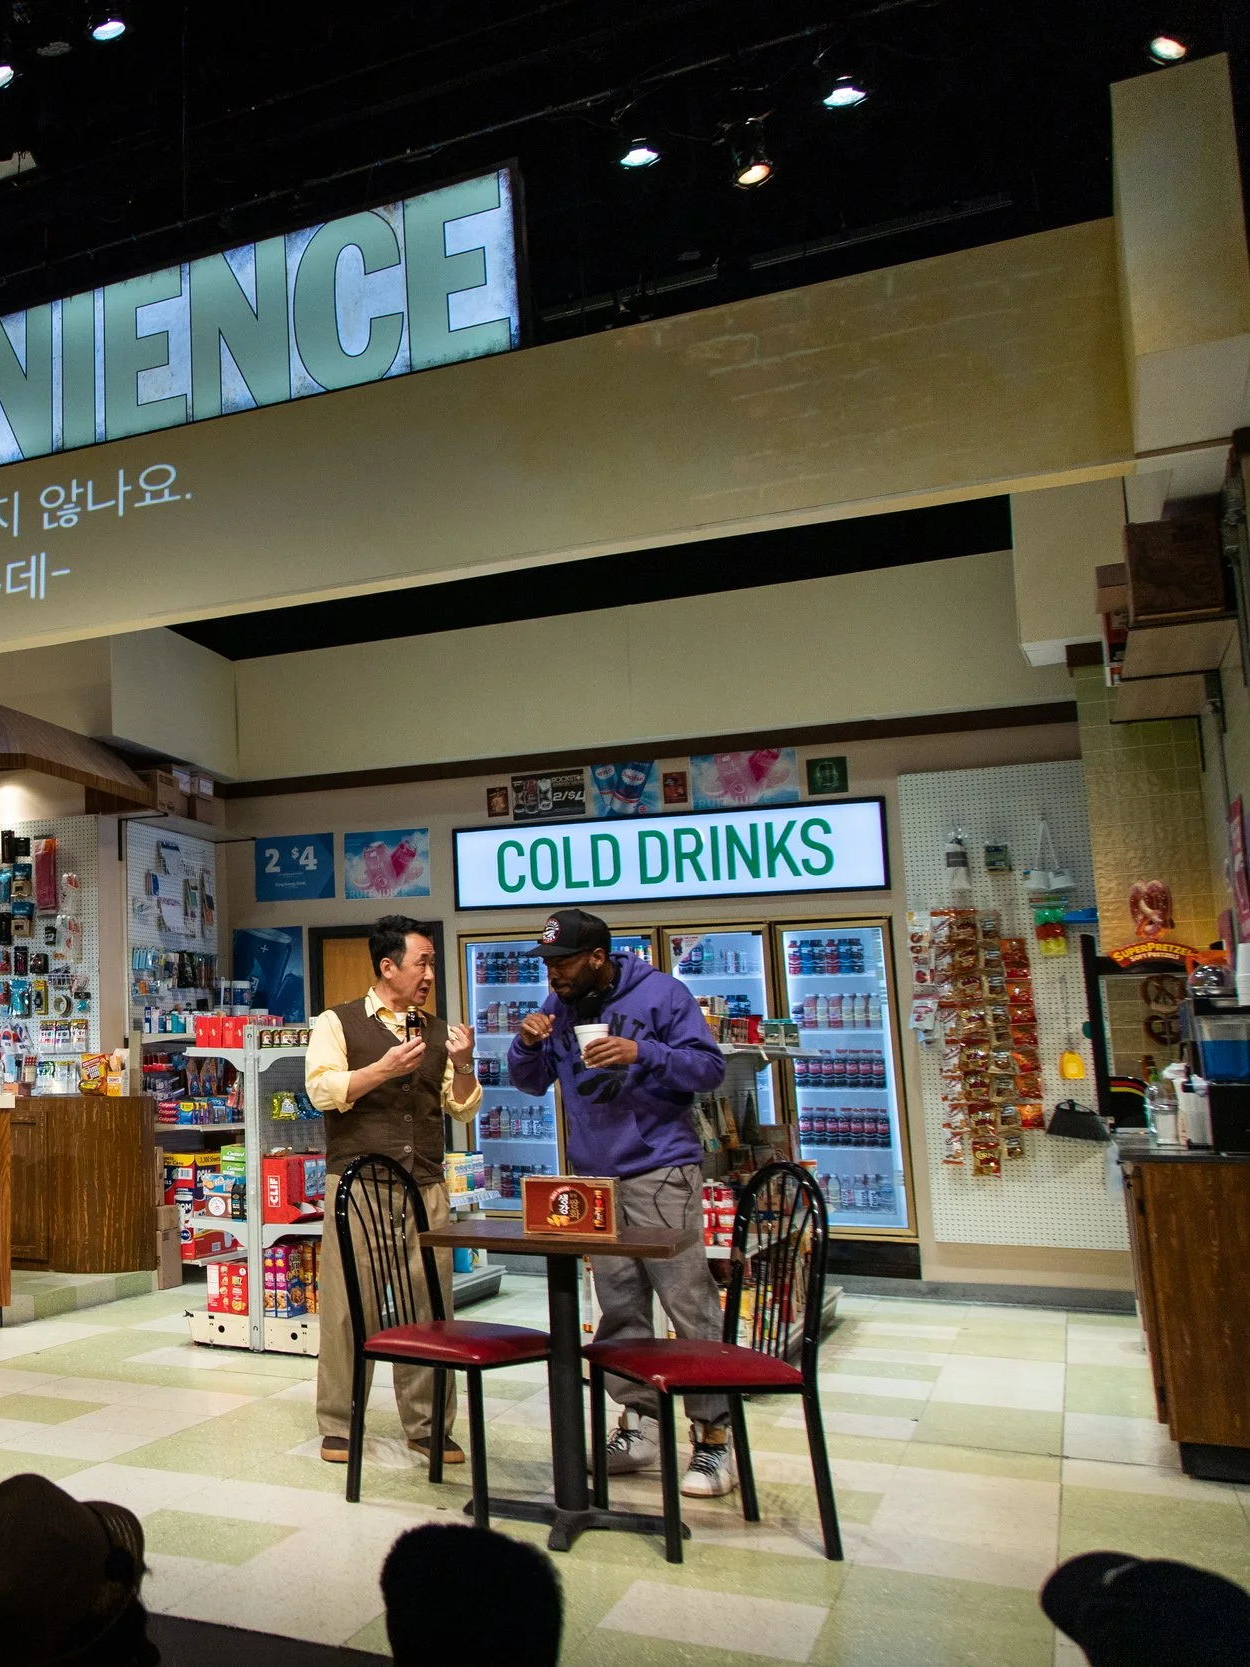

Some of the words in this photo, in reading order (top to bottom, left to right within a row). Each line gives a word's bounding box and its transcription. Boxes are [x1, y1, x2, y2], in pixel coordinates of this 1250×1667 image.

[39, 463, 192, 530] 않나요.
[265, 849, 280, 873] 2
[291, 846, 318, 871] $4
[497, 833, 622, 893] COLD
[638, 817, 835, 885] DRINKS
[1129, 952, 1147, 962] SOFT
[1147, 950, 1180, 960] PRETZELS
[269, 1178, 279, 1205] CLIF
